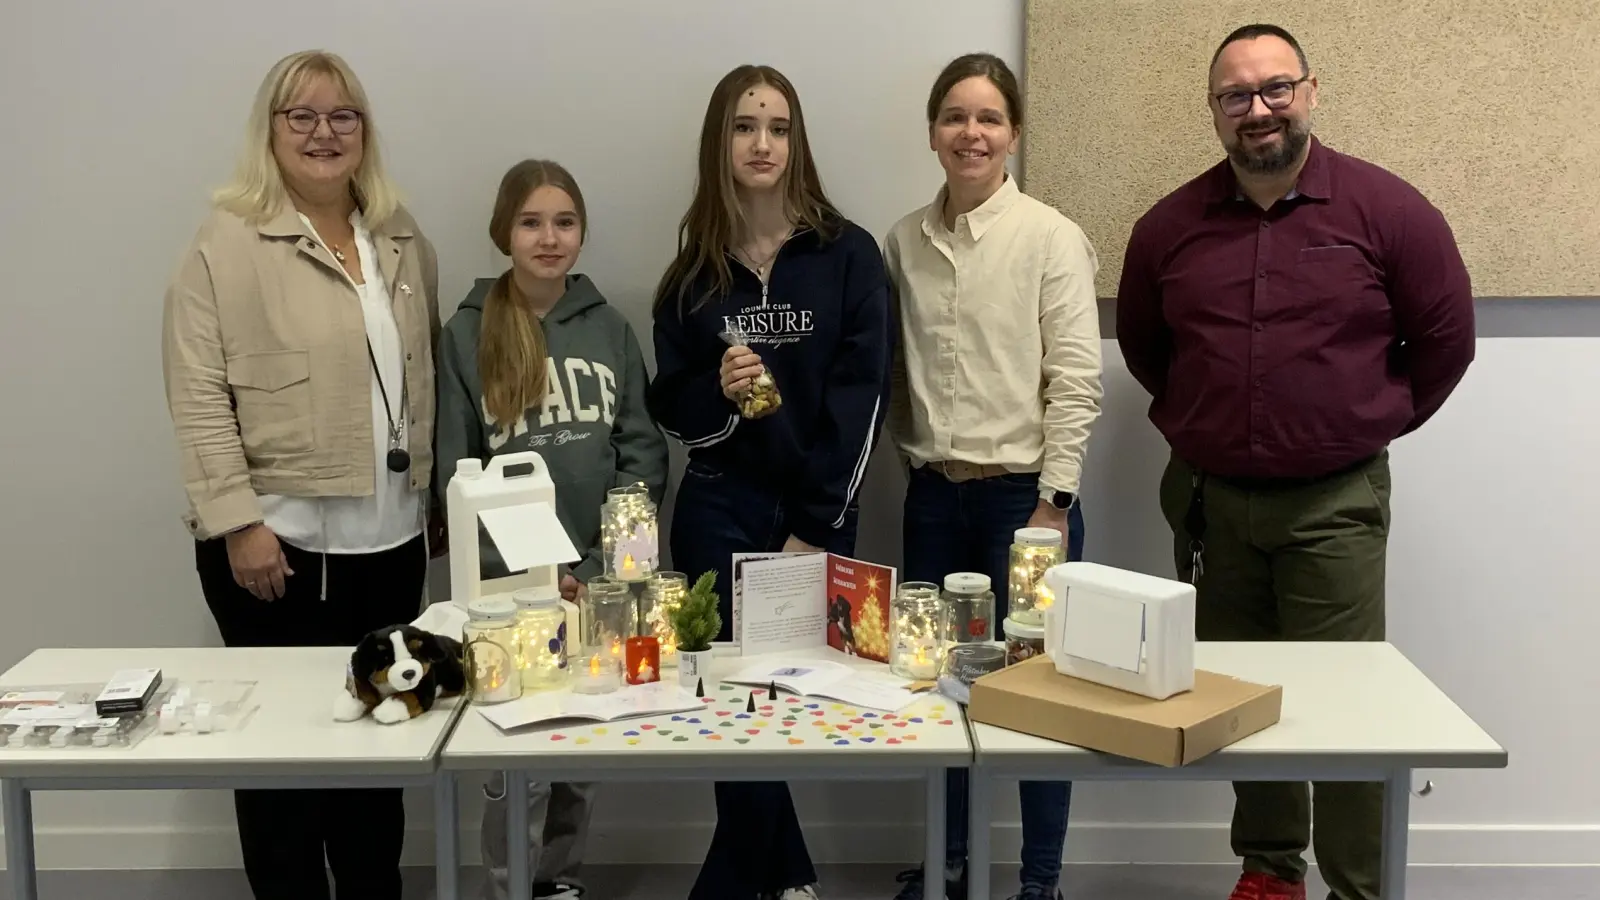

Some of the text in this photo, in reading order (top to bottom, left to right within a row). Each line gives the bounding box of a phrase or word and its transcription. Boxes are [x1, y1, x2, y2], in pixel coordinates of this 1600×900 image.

[722, 311, 814, 333] LEISURE
[768, 335, 800, 349] elegance
[481, 356, 617, 451] ACE
[528, 429, 592, 446] To Grow
